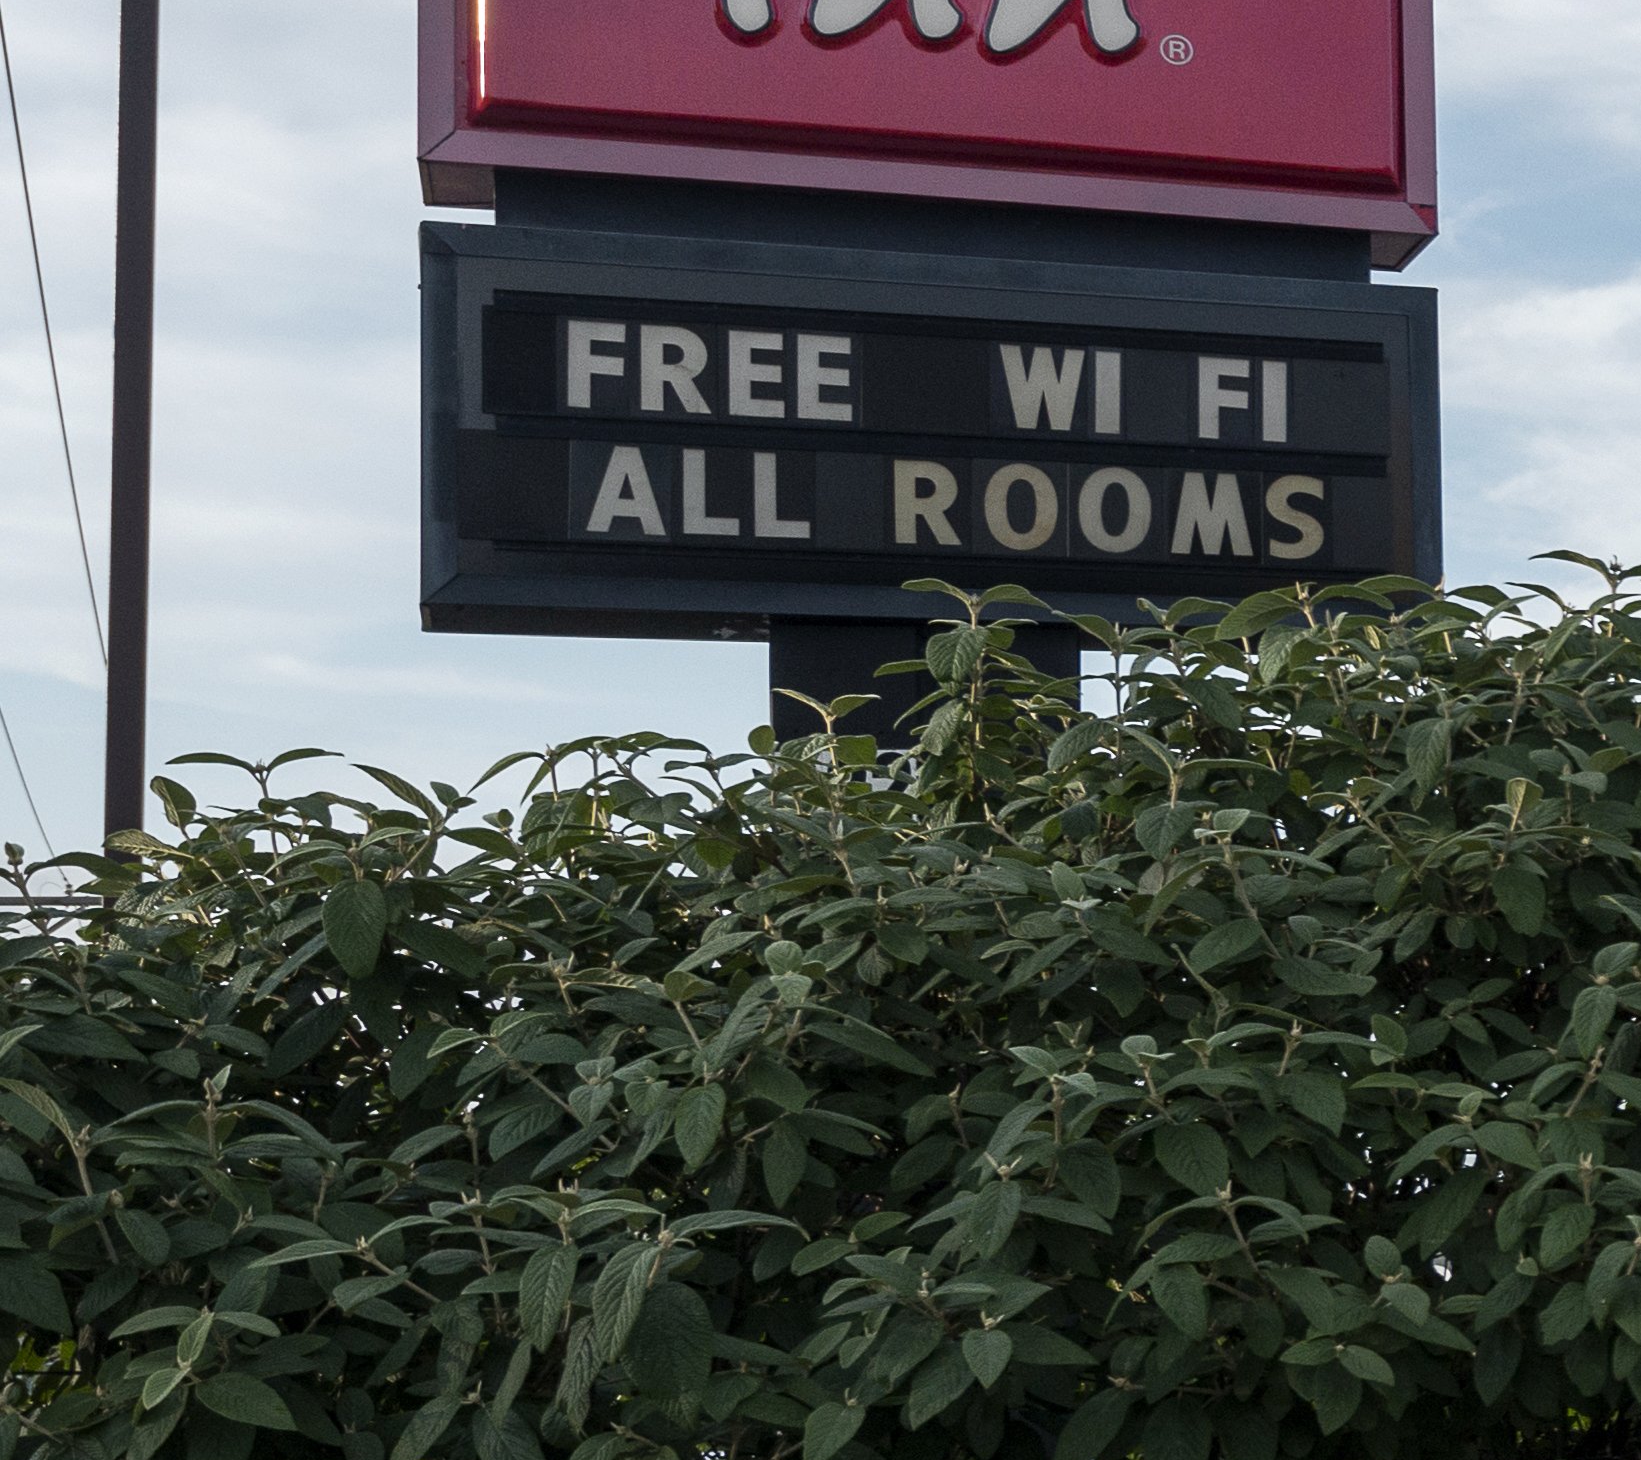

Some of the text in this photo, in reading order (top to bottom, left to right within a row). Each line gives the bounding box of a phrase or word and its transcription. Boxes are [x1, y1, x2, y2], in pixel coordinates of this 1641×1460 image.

[565, 319, 1288, 444] FREE WI FI
[585, 445, 1325, 560] ALL ROOMS
